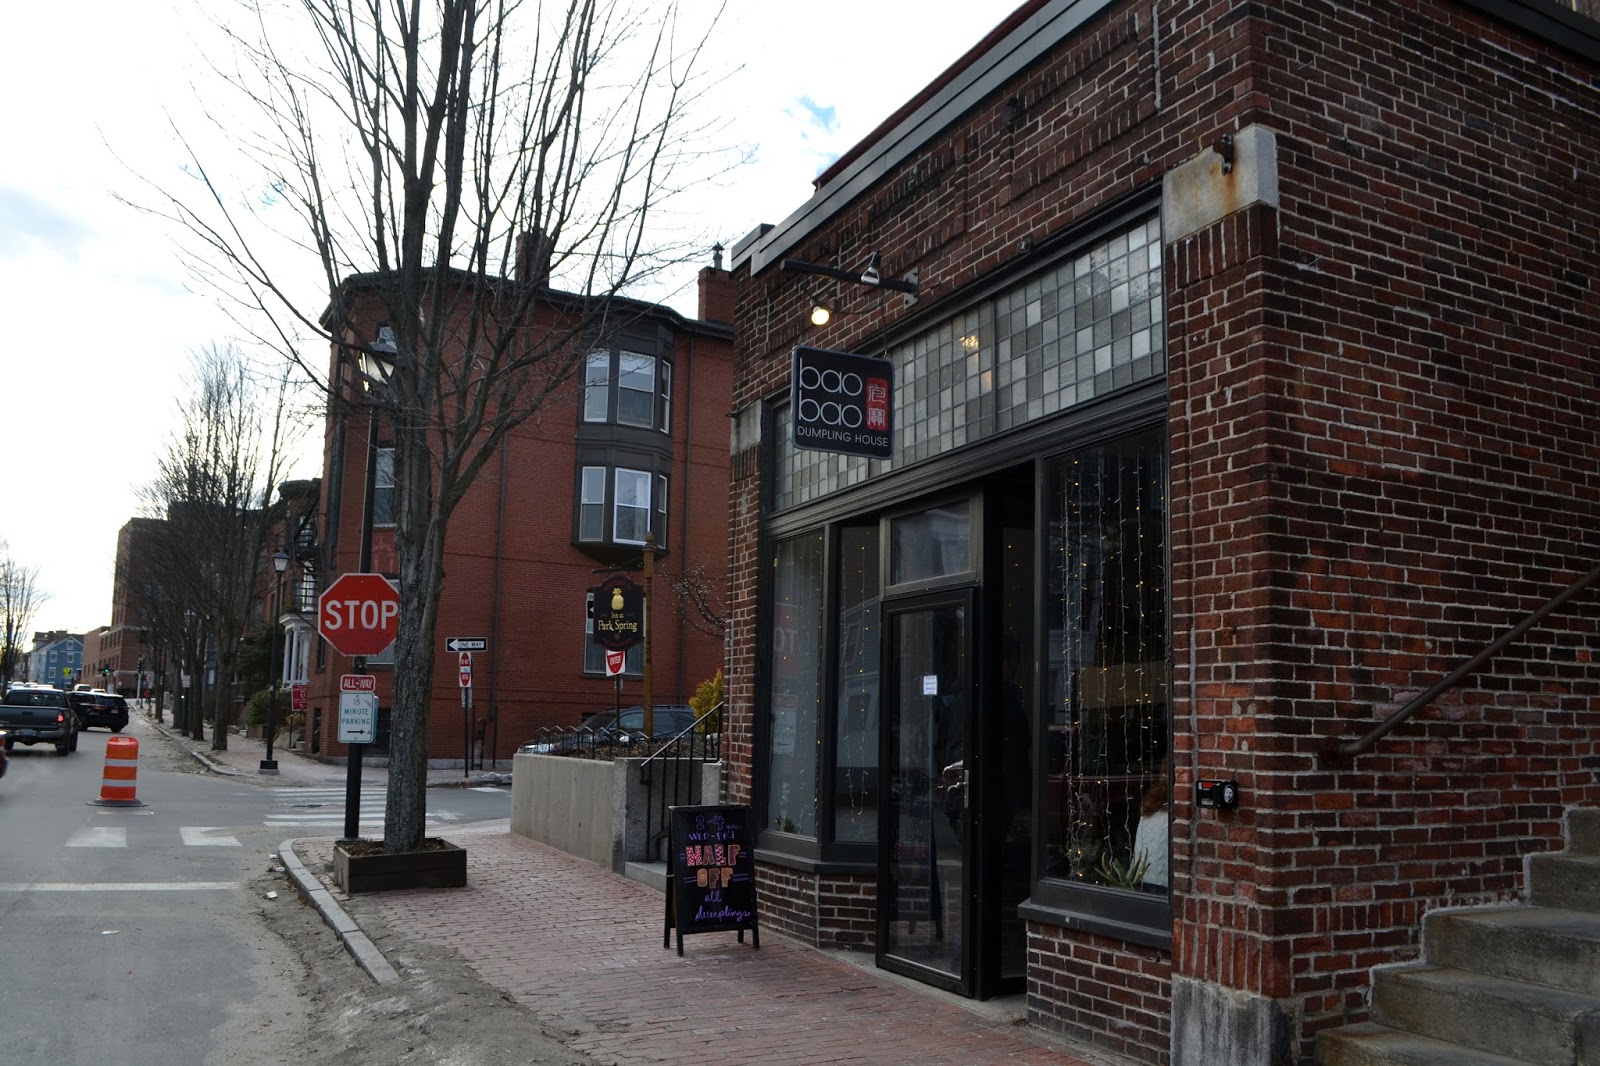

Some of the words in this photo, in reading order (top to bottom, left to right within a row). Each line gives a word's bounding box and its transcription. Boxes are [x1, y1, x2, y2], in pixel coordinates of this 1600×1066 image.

[799, 357, 863, 396] bao
[798, 389, 863, 428] bao
[797, 426, 852, 442] DUMPLING
[855, 434, 888, 447] HOUSE
[324, 600, 399, 630] STOP
[597, 619, 615, 632] Park
[614, 619, 638, 633] Spring
[343, 677, 373, 689] ALL-WAY
[353, 698, 361, 706] 15
[341, 717, 371, 726] PARKING
[344, 708, 369, 716] MINUTE
[685, 843, 741, 867] HALF
[696, 867, 734, 890] OFF
[704, 890, 722, 903] all
[694, 904, 751, 923] dumplings
